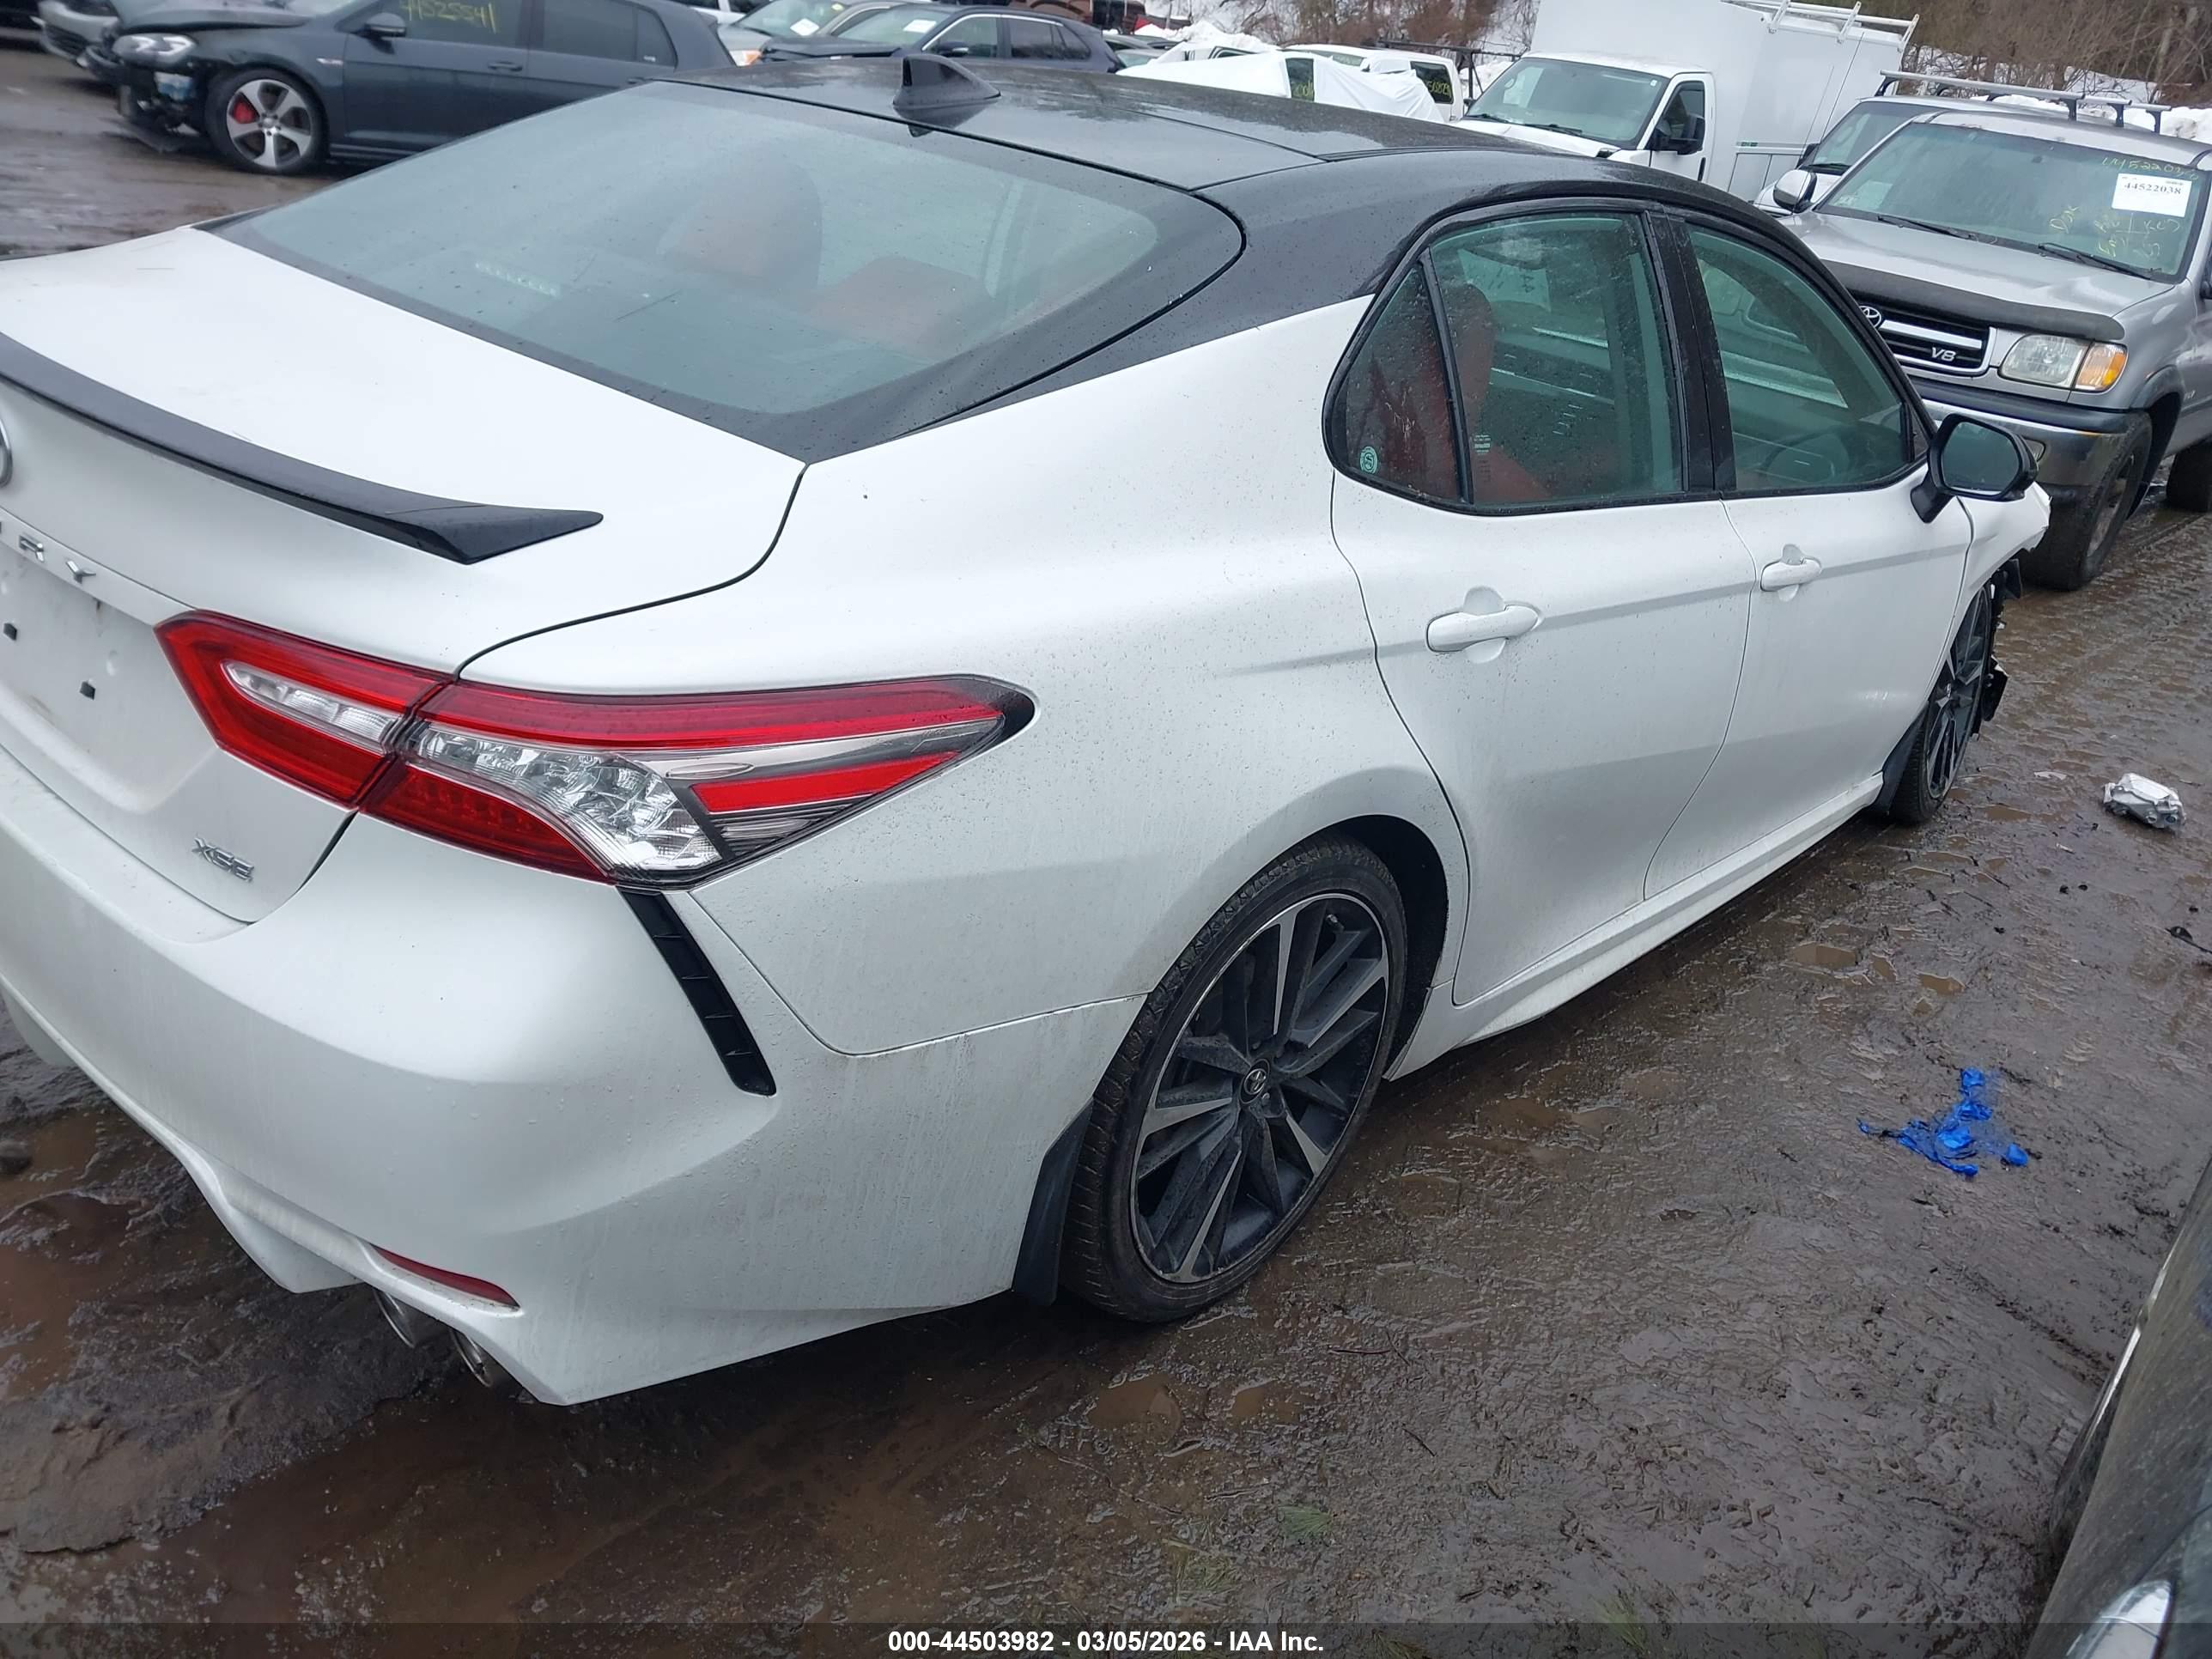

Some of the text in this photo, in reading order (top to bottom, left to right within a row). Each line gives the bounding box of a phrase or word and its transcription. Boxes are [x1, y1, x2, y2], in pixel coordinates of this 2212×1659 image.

[2124, 181, 2183, 195] 44522038
[1931, 346, 1957, 362] V8
[0, 520, 96, 585] RY
[191, 836, 255, 882] XSE
